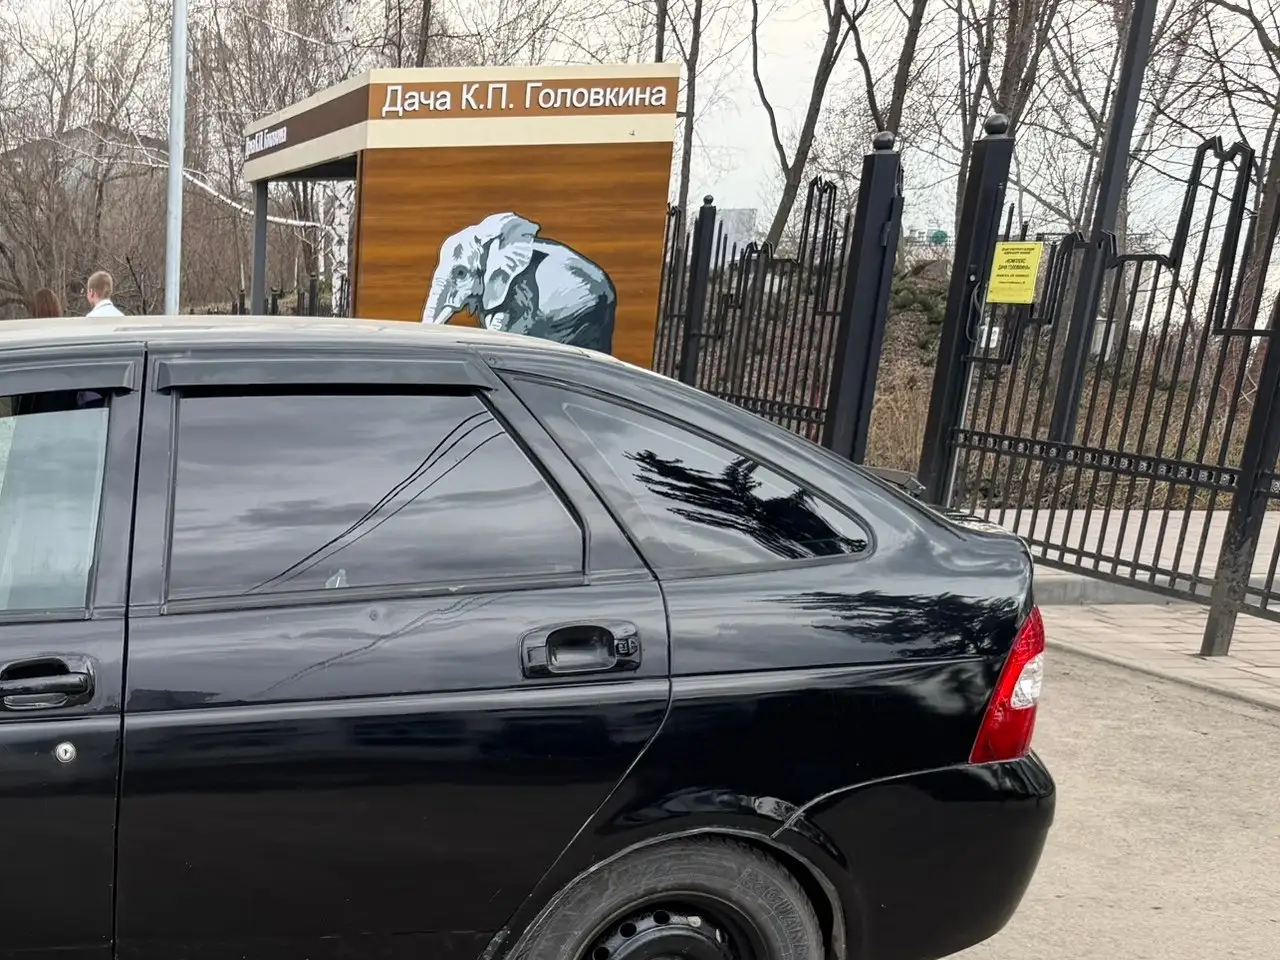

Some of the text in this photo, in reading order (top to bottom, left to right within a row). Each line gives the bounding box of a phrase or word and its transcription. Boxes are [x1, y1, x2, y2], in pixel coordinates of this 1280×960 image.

[382, 82, 667, 117] Дача К.П. Головкина
